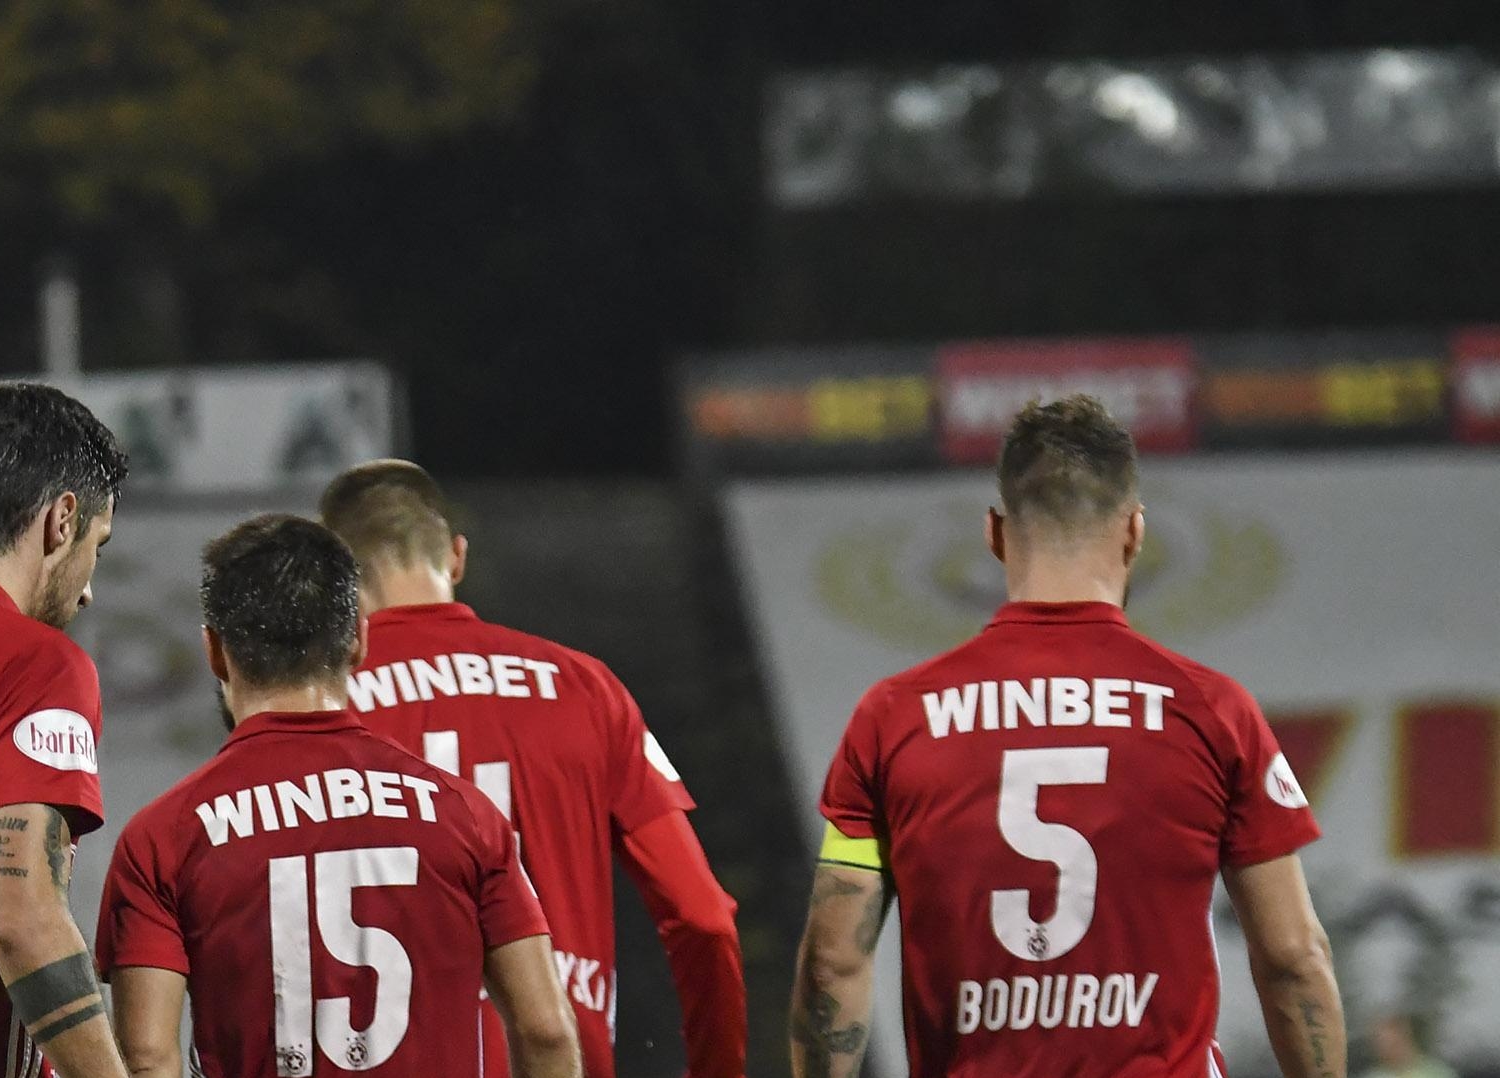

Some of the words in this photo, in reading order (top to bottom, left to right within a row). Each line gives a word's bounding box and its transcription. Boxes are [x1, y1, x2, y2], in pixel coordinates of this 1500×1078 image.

[347, 653, 560, 712] WINBET
[922, 677, 1175, 739] WINBET
[195, 768, 439, 847] WINBET
[990, 746, 1109, 962] 5
[269, 847, 419, 1078] 15
[957, 973, 1159, 1035] BODUROV
